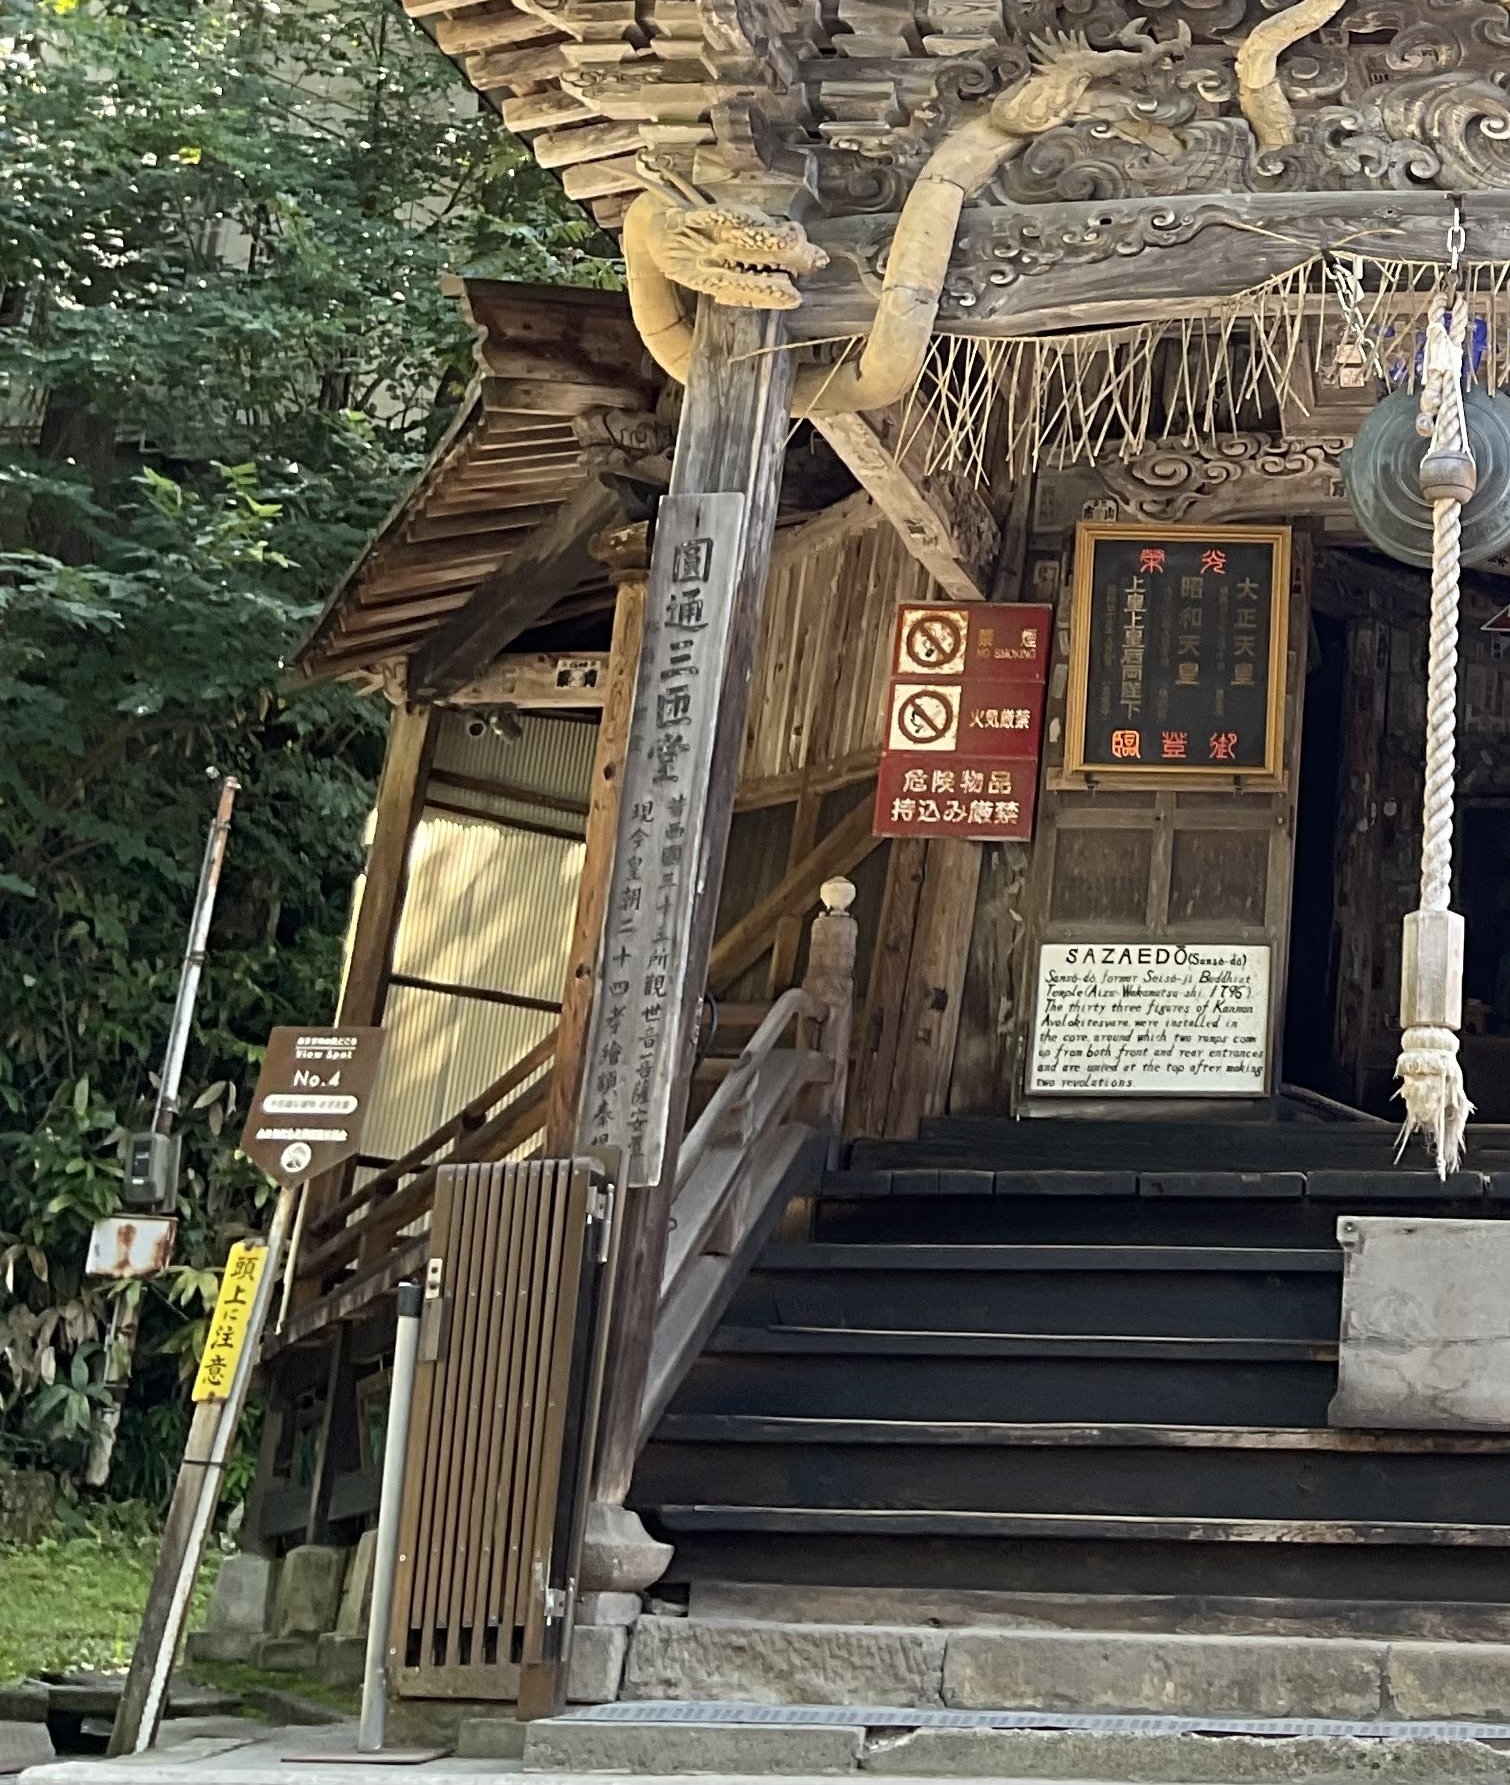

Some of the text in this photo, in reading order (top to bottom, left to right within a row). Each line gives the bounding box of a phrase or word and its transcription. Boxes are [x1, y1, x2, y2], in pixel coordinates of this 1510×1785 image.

[1175, 577, 1204, 685] 昭和天皇
[1231, 577, 1259, 686] 大正天皇
[969, 709, 1031, 729] 火気厳禁
[903, 769, 1012, 795] 危険物品
[891, 798, 1020, 825] 持込み厳禁
[1045, 999, 1063, 1015] The
[1146, 1000, 1190, 1016] figures
[1196, 1000, 1209, 1014] of
[1213, 999, 1253, 1014] Kannon
[1166, 1016, 1219, 1028] installed
[1225, 1019, 1238, 1028] in
[1040, 1029, 1057, 1043] the
[1094, 1029, 1133, 1042] around
[1137, 1030, 1167, 1042] which
[1174, 1032, 1191, 1042] two
[296, 1050, 353, 1060] View Spot
[1055, 1044, 1082, 1059] from
[1086, 1044, 1111, 1057] both
[1118, 1044, 1148, 1059] front
[1154, 1044, 1172, 1057] and
[1179, 1048, 1202, 1058] rear
[1209, 1047, 1264, 1058] entrances
[1037, 1059, 1058, 1072] and
[1062, 1063, 1080, 1072] are
[1123, 1062, 1136, 1072] at
[1142, 1058, 1161, 1072] the
[1167, 1062, 1184, 1074] top
[1189, 1060, 1221, 1073] after
[1226, 1060, 1263, 1077] making
[293, 1068, 341, 1088] No.4
[1036, 1077, 1055, 1087] two
[202, 1256, 259, 1386] 頭上に注意
